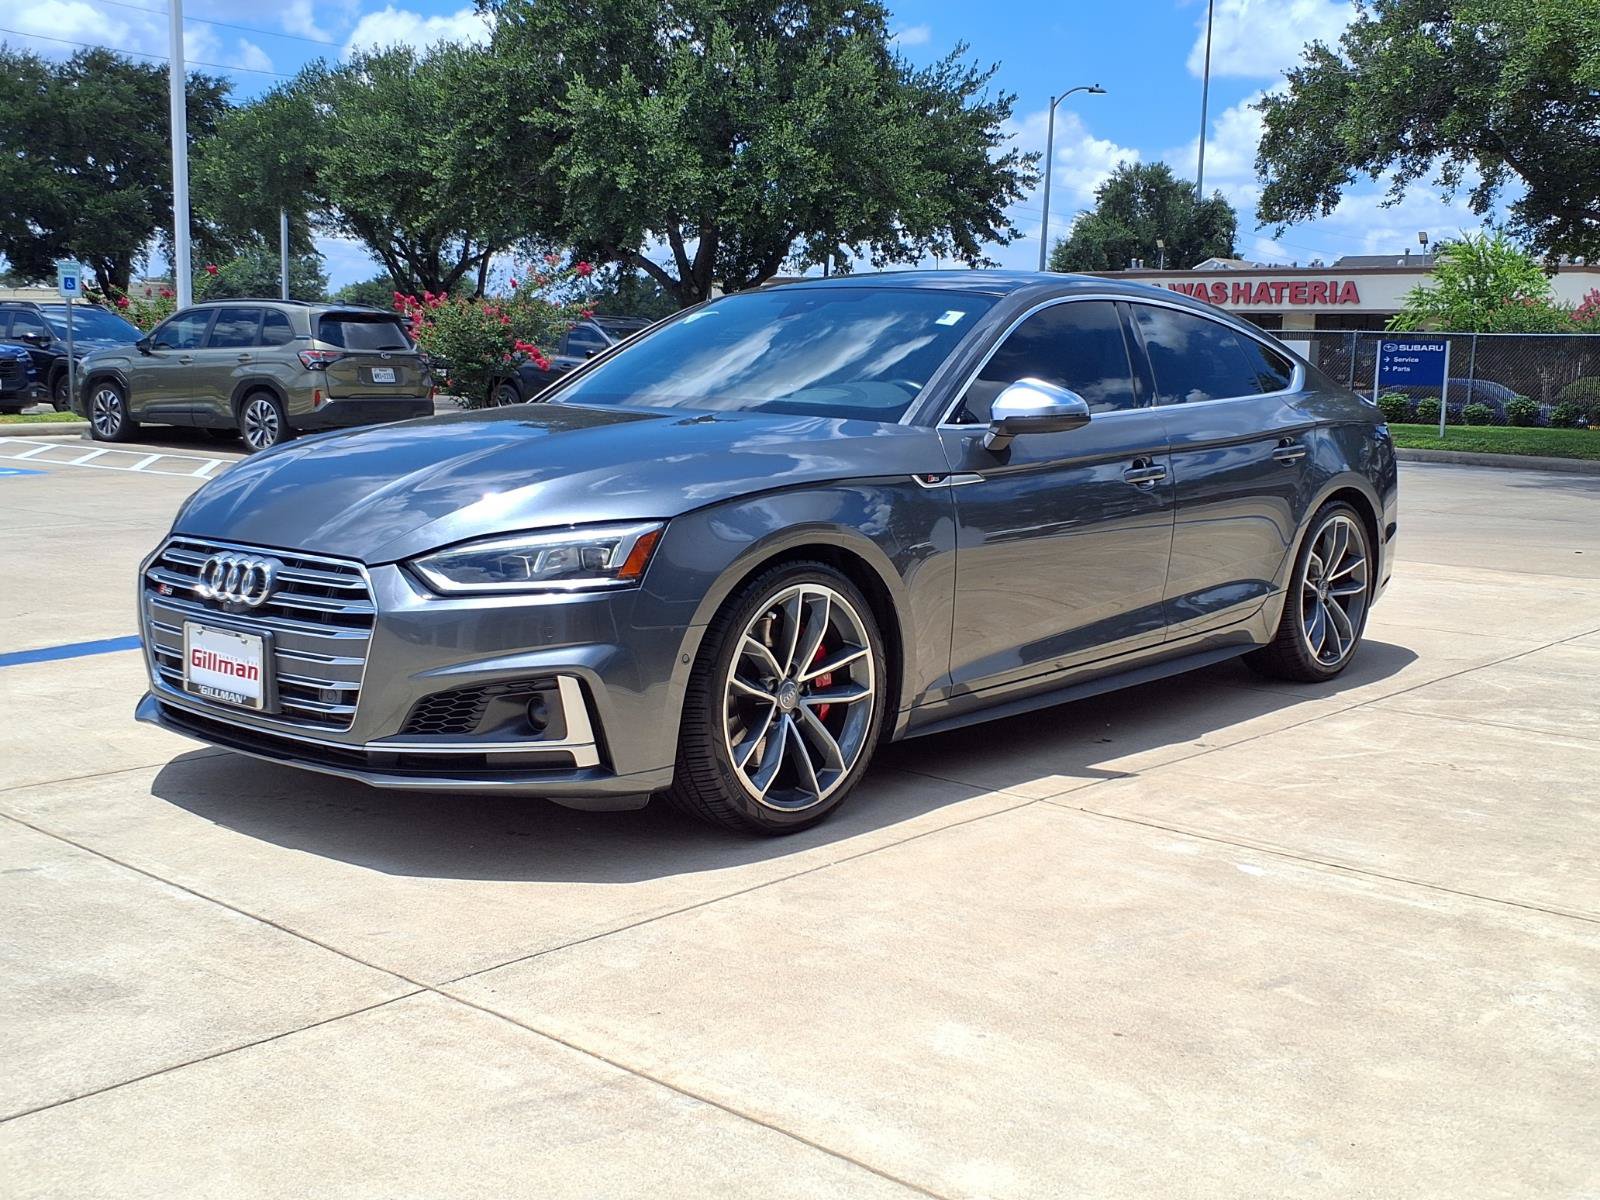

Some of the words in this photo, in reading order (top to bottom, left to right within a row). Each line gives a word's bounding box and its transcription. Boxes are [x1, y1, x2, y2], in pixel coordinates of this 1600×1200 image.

[1398, 344, 1444, 352] SUBARU
[192, 648, 259, 681] Gillman
[200, 685, 243, 704] GILLMAN
